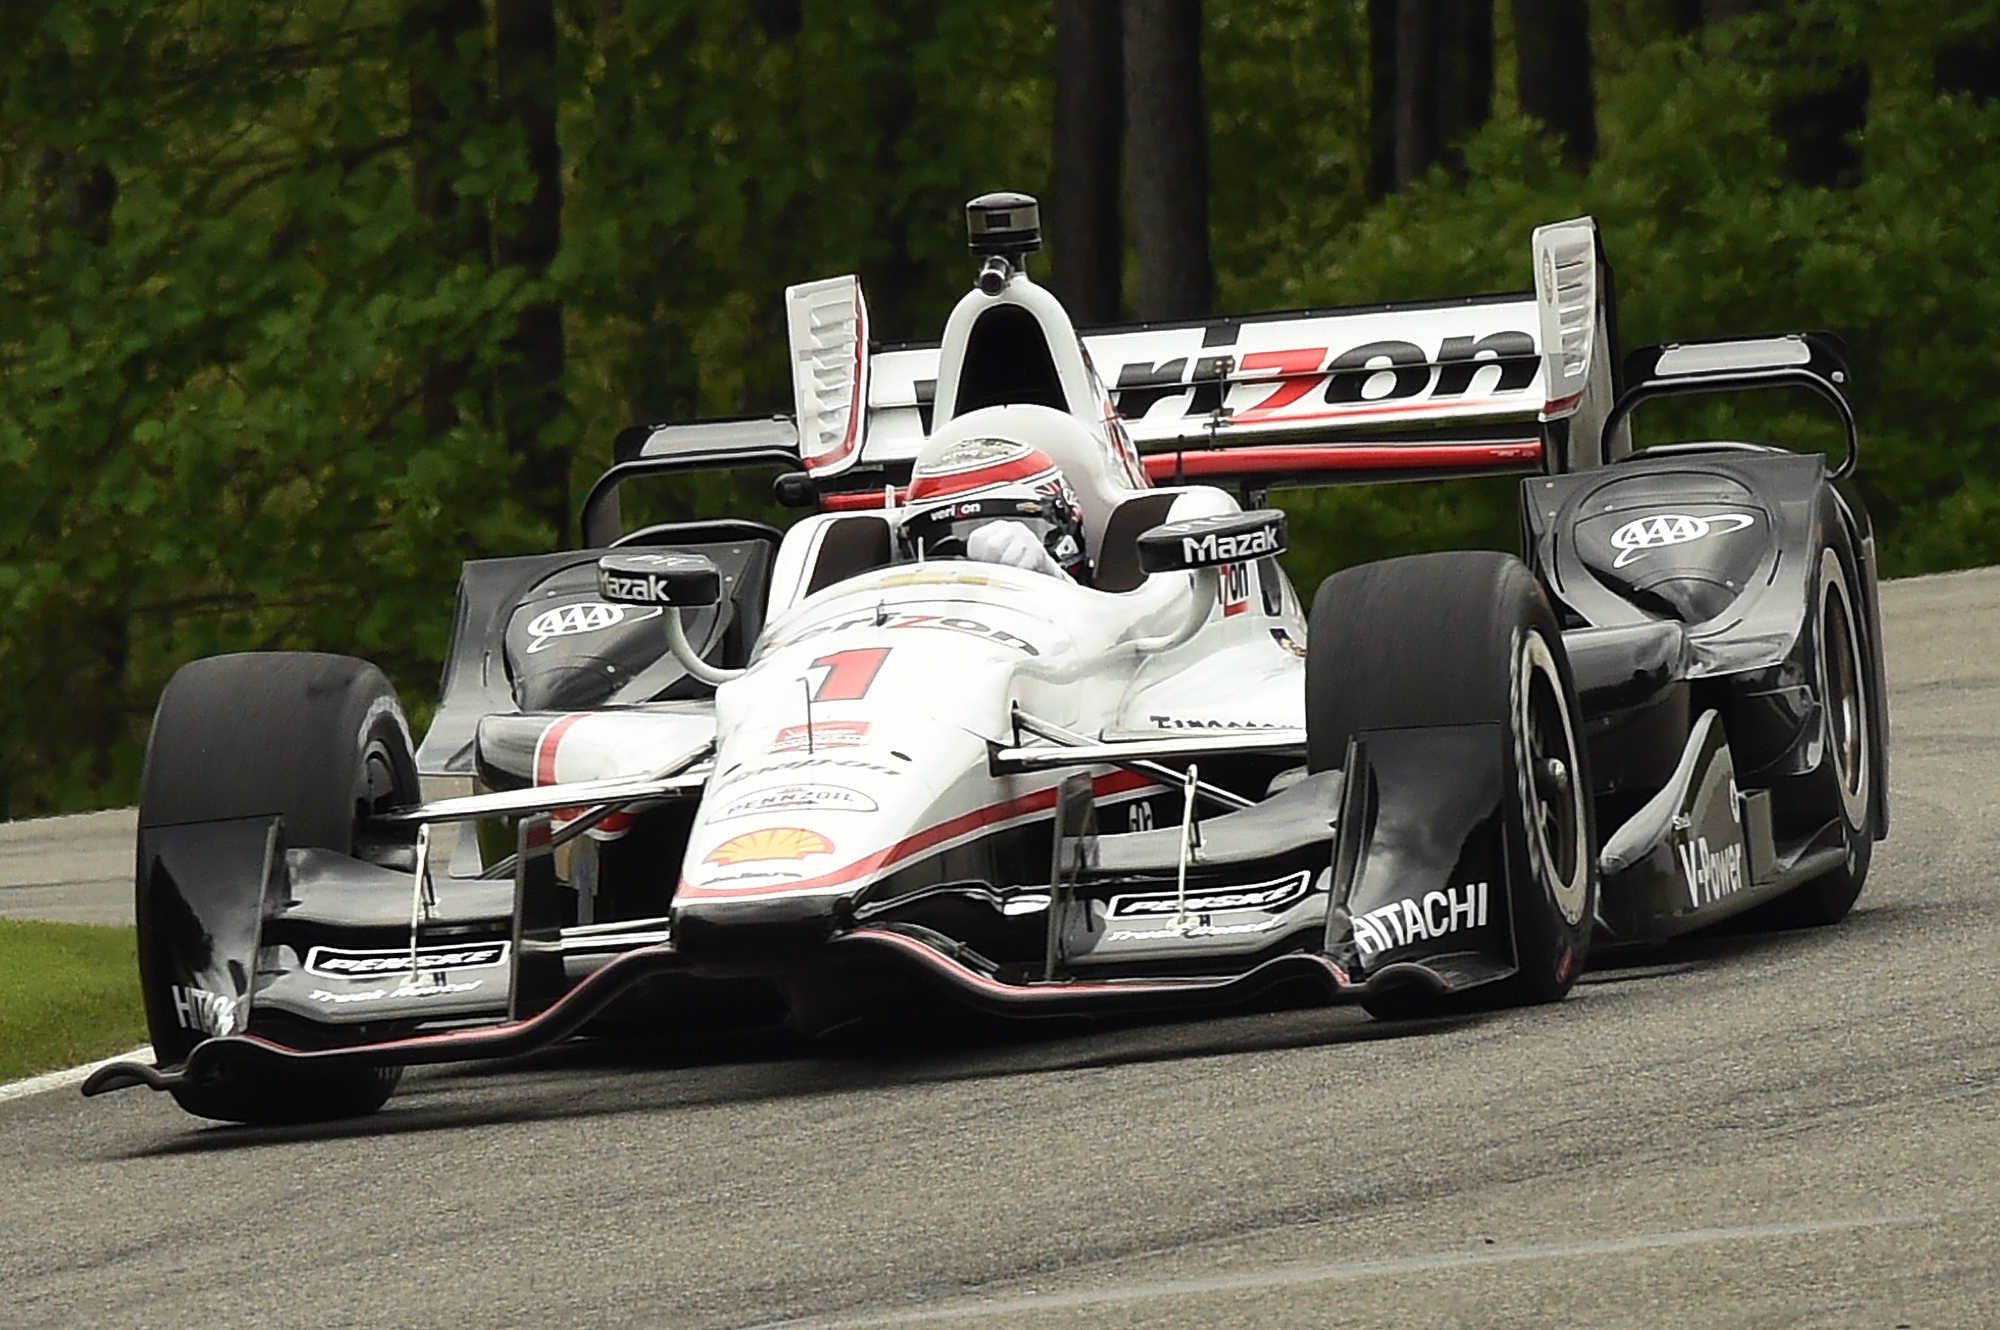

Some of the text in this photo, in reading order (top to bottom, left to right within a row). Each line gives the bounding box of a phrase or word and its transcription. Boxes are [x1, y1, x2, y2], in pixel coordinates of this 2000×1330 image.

[1182, 524, 1279, 564] Mazak
[1621, 514, 1704, 548] AAA
[600, 571, 671, 602] azak
[533, 603, 616, 636] AAA
[807, 646, 893, 703] 1
[727, 790, 856, 816] PENNZOIL
[1678, 836, 1742, 908] V-Power
[1350, 882, 1488, 954] HITACHI
[318, 949, 500, 972] PENSKE
